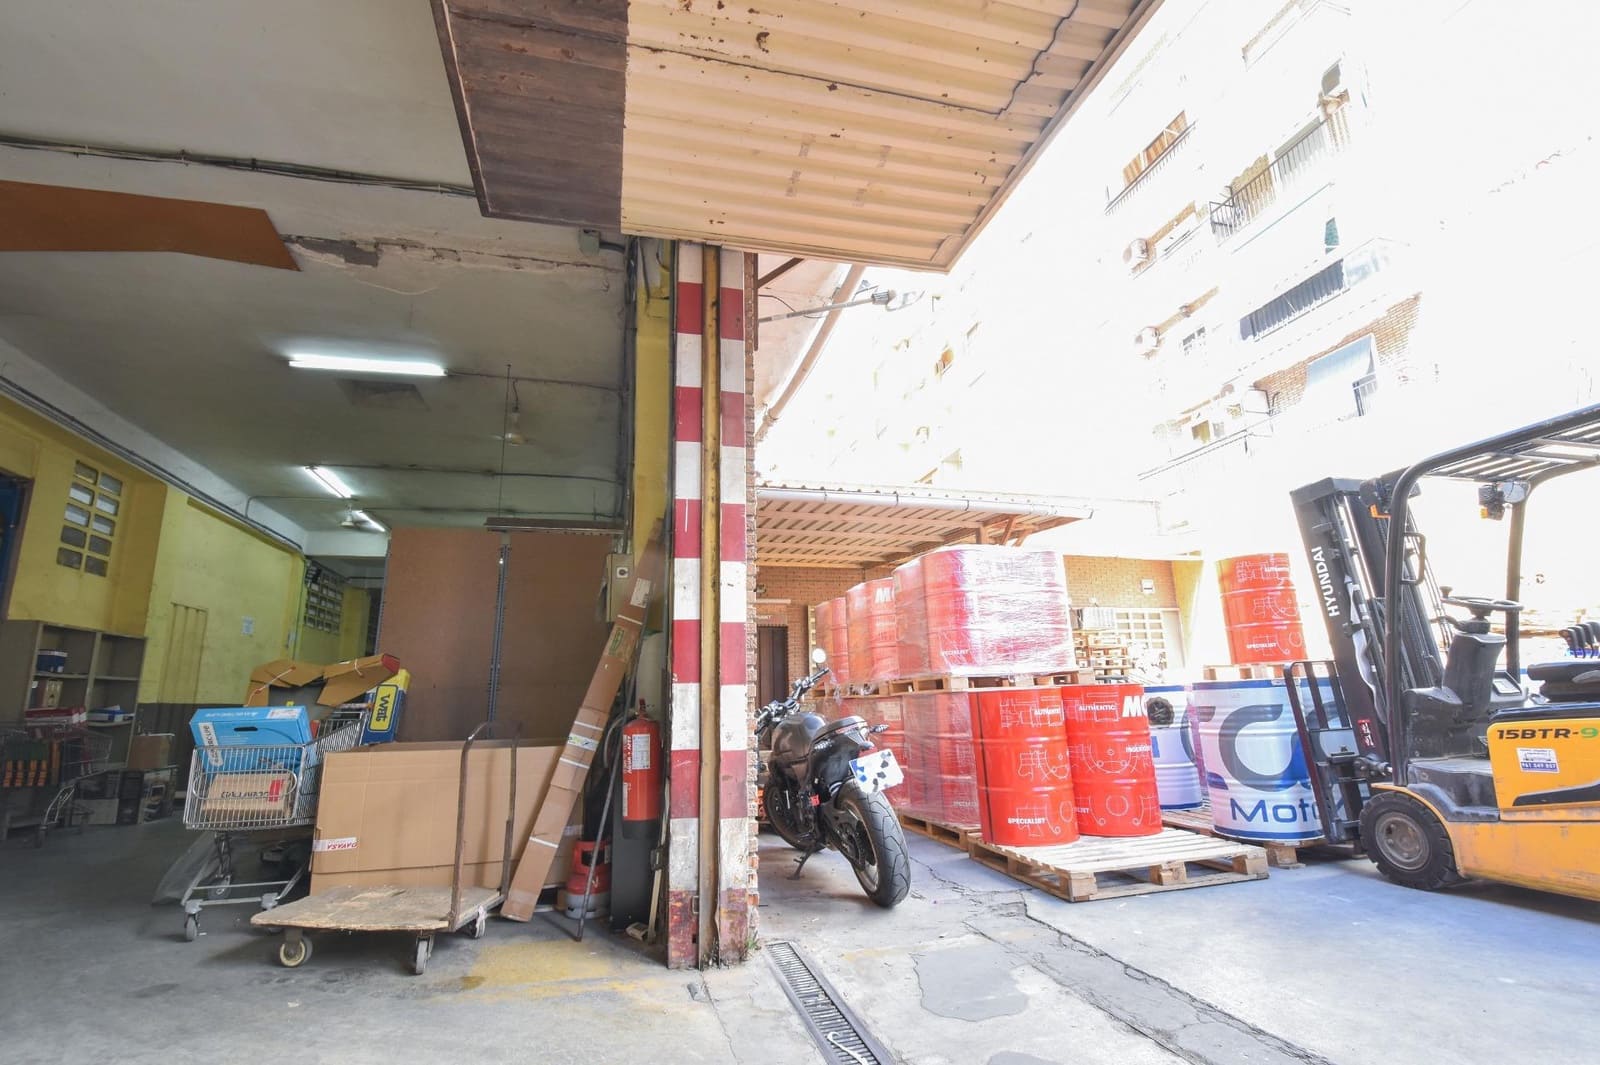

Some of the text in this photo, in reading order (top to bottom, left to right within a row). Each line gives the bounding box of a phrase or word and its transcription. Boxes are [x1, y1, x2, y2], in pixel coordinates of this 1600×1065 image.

[1311, 546, 1340, 617] HYUNDAI
[1497, 727, 1599, 740] 15BTR-9
[1007, 817, 1046, 825] SPECIALIST
